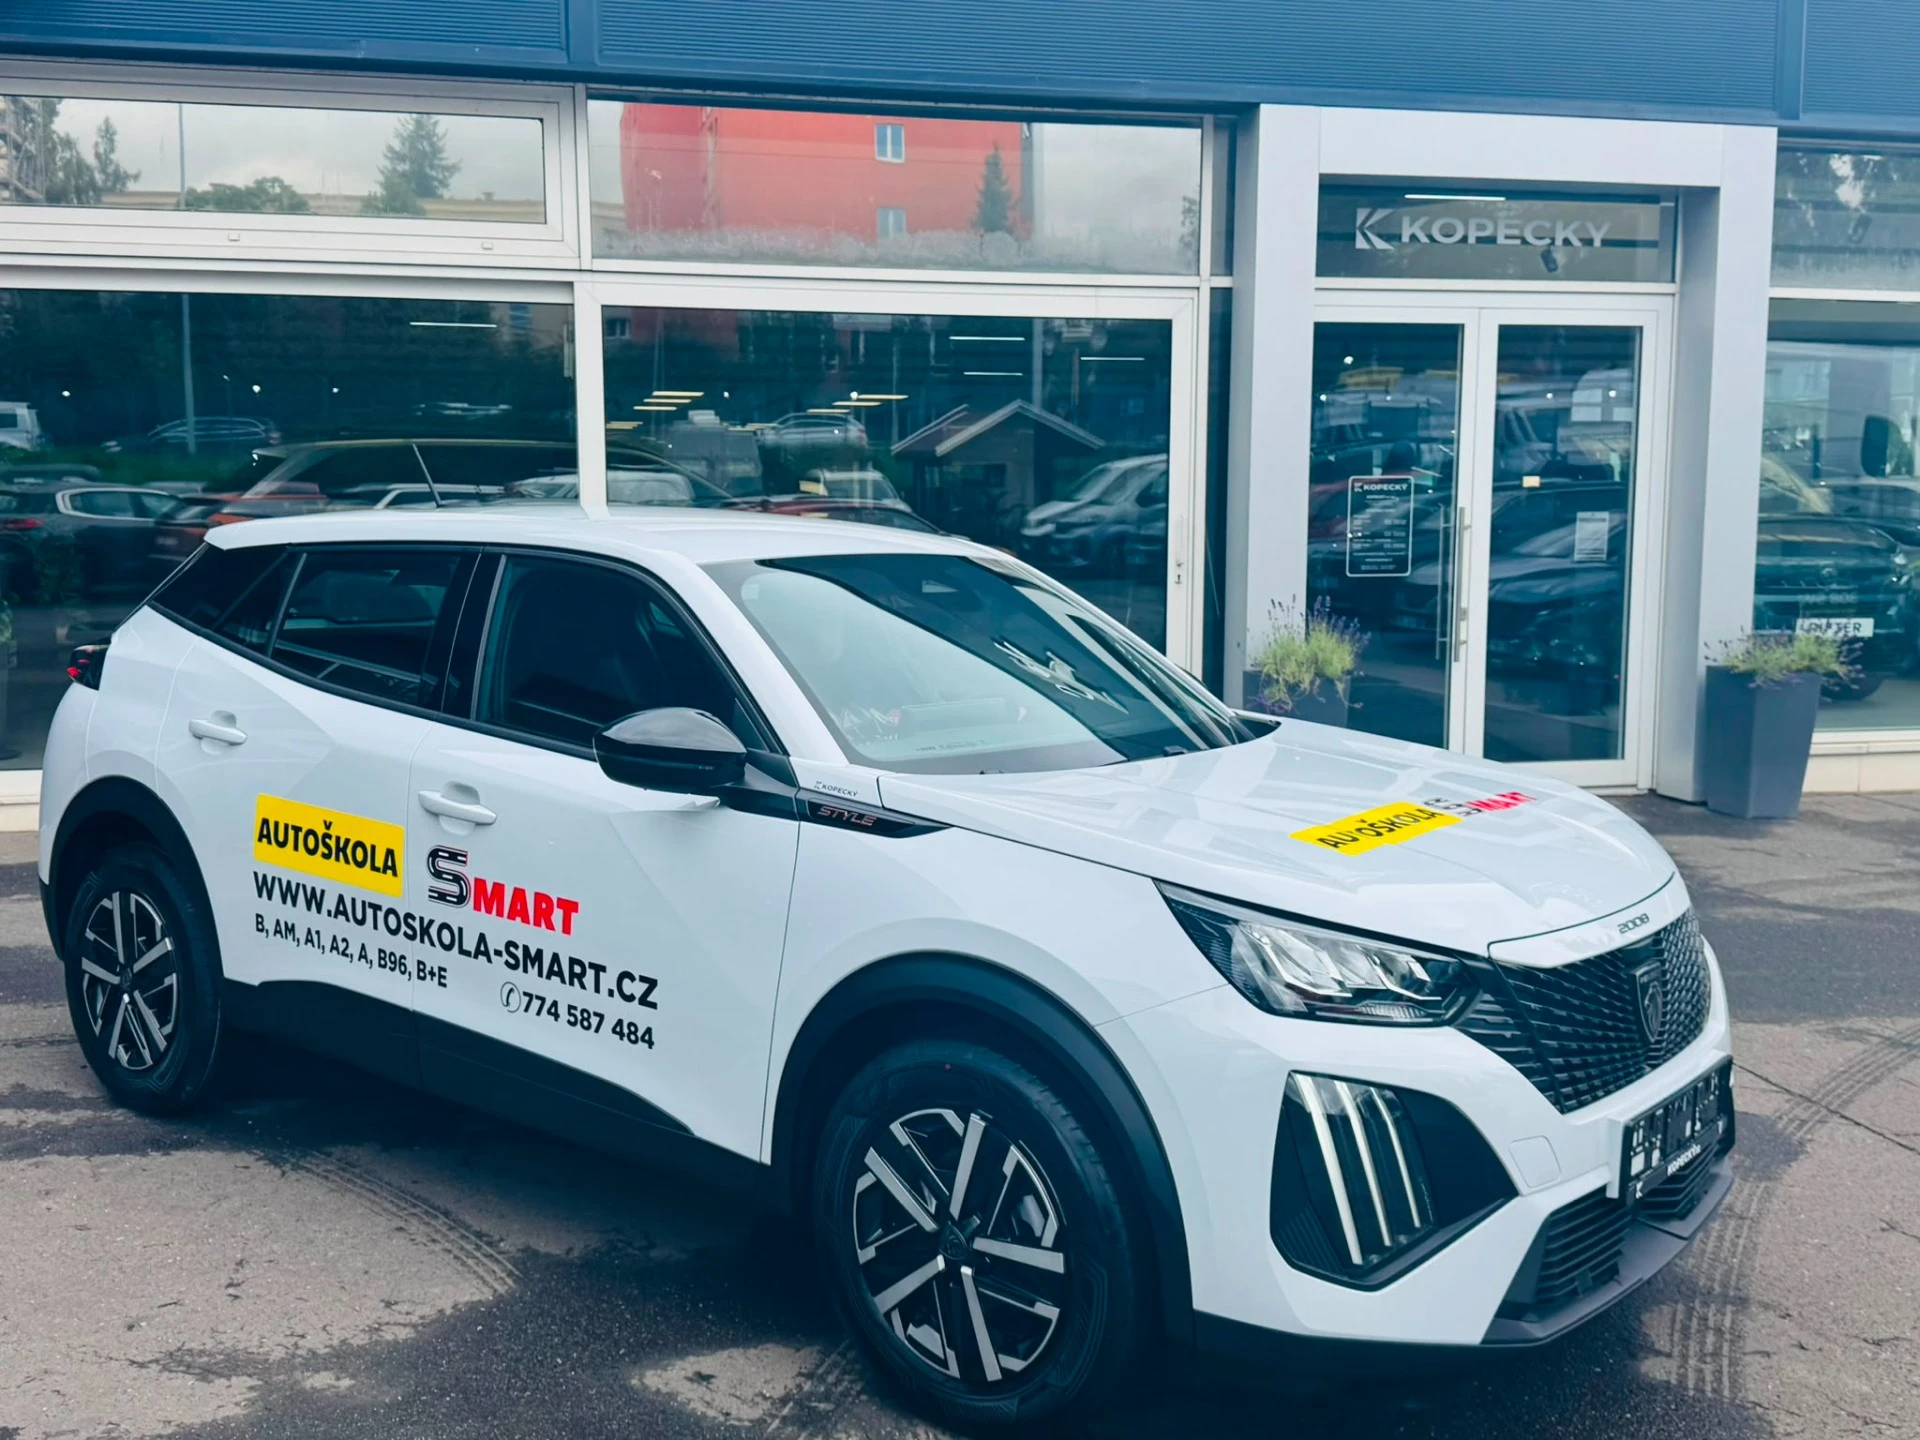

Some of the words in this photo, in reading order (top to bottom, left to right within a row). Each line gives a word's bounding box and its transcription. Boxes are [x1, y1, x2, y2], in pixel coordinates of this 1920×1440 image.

[1401, 215, 1611, 248] KOPECKY
[817, 805, 878, 826] STYLE
[257, 820, 398, 877] AUTOŠKOLA
[426, 844, 580, 936] SMART
[253, 871, 658, 1010] WWW.AUTOSKOLA-SMART.CZ
[255, 913, 269, 938] B,
[273, 918, 300, 947] AM,
[304, 927, 325, 954] A1,
[329, 934, 353, 964] A2,
[357, 943, 373, 969] A,
[378, 948, 412, 981] B96,
[417, 959, 447, 988] B+E
[1617, 913, 1650, 934] 2008
[522, 991, 560, 1022] 774
[567, 1003, 605, 1034] 587
[611, 1018, 655, 1050] 484
